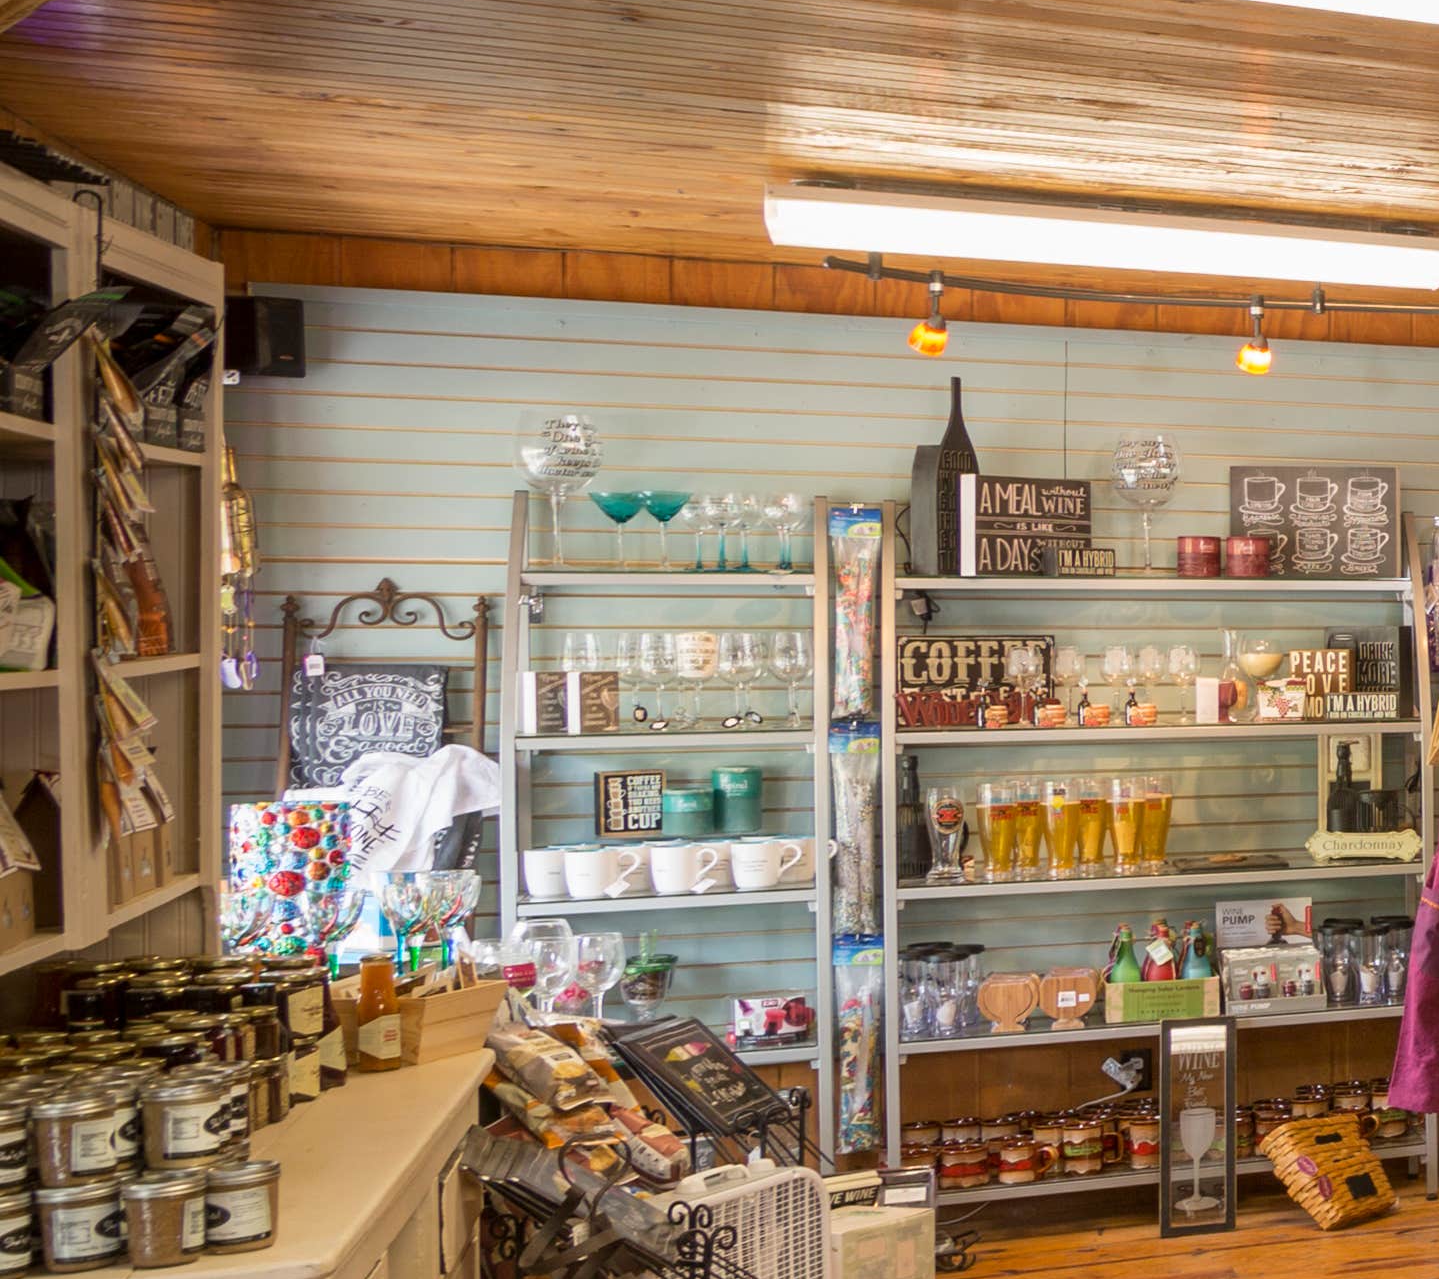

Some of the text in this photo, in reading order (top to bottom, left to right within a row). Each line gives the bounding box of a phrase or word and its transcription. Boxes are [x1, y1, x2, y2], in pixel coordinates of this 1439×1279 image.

[980, 482, 1086, 515] A MEAL without
[1041, 497, 1085, 514] WINE
[1032, 523, 1053, 531] LIKE
[980, 538, 992, 570] A
[997, 538, 1032, 571] DAY
[1083, 550, 1113, 567] HYBRID
[1291, 651, 1347, 673] PEACE
[336, 686, 425, 707] ALL YOU NEED
[1327, 695, 1343, 711] I'M
[1347, 695, 1355, 711] A
[1357, 695, 1397, 711] HYBRID
[373, 701, 384, 712] IS
[338, 711, 414, 738] LOVE
[628, 813, 661, 829] CUP
[1322, 840, 1404, 851] Chardonnay
[1222, 915, 1255, 925] PUMP
[845, 1187, 877, 1203] WINE
